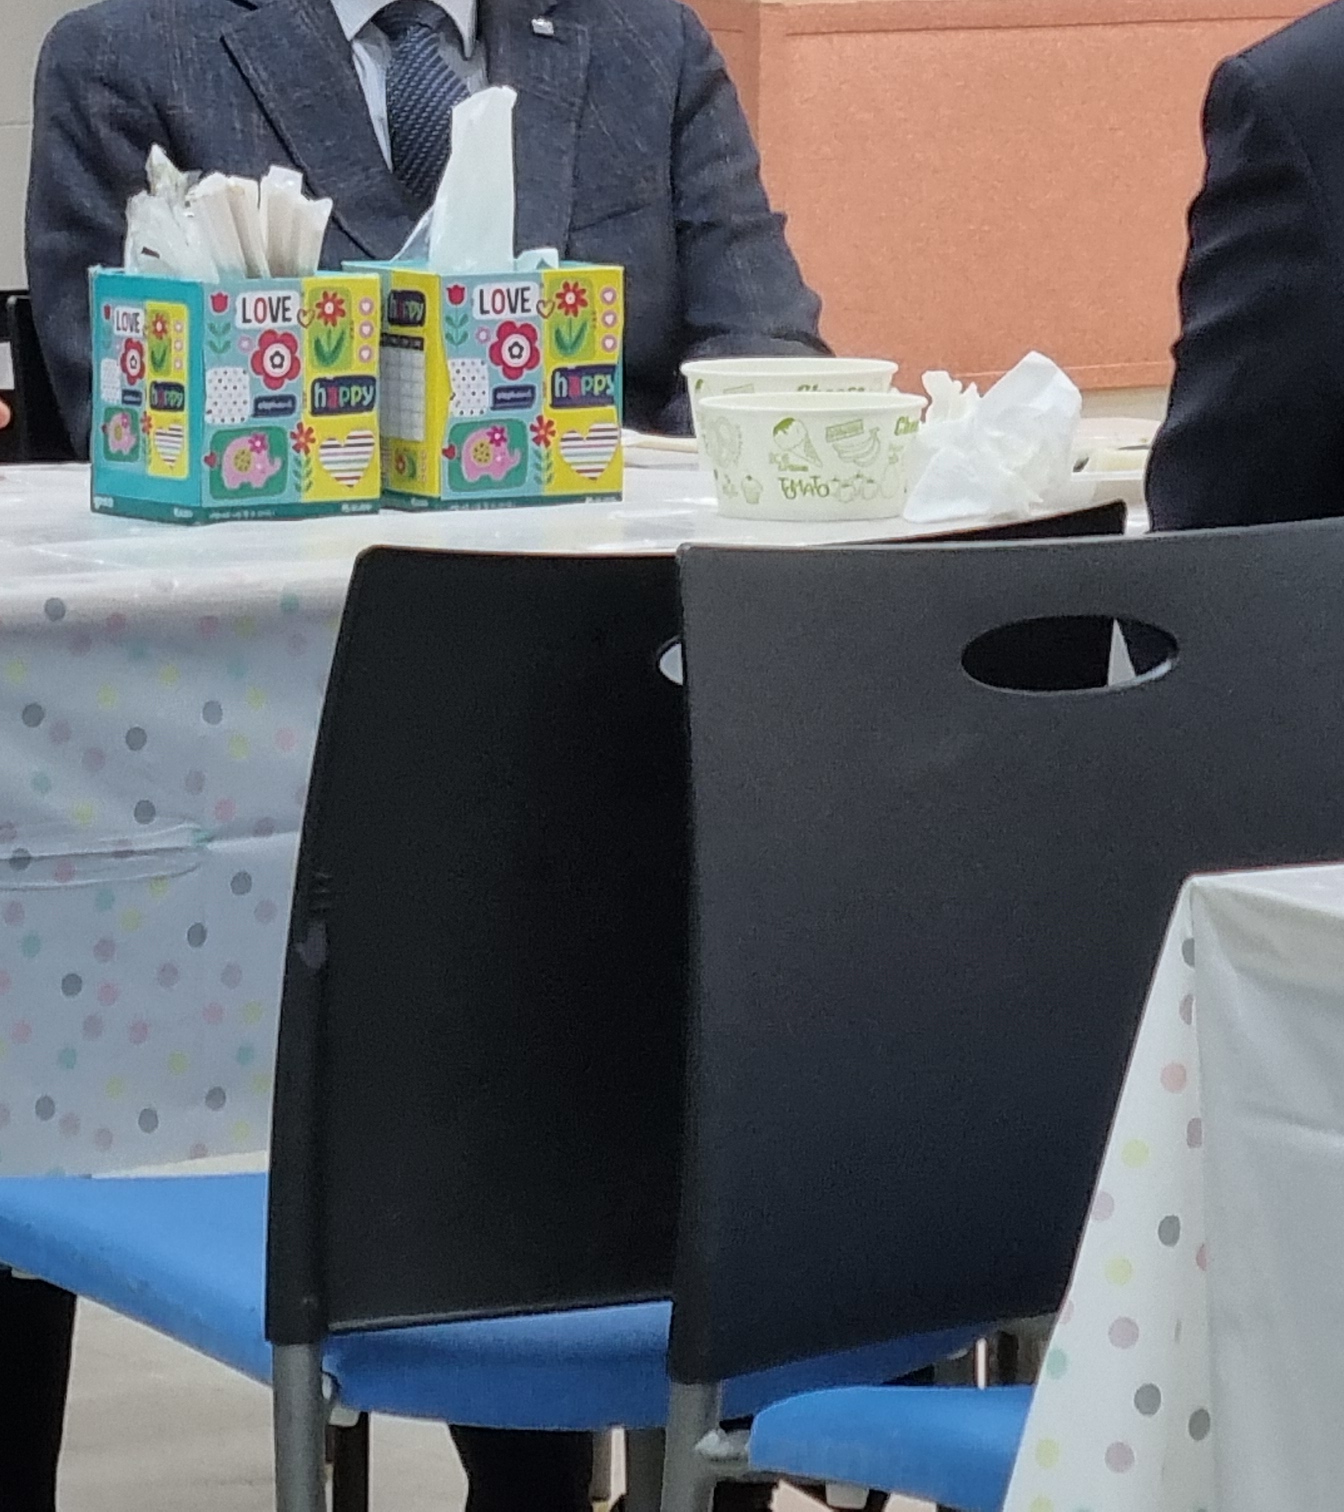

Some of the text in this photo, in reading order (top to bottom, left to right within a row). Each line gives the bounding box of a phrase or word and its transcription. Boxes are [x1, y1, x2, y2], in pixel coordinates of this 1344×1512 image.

[241, 295, 293, 324] LOVE
[479, 286, 532, 315] LOVE
[115, 312, 141, 334] LOVE
